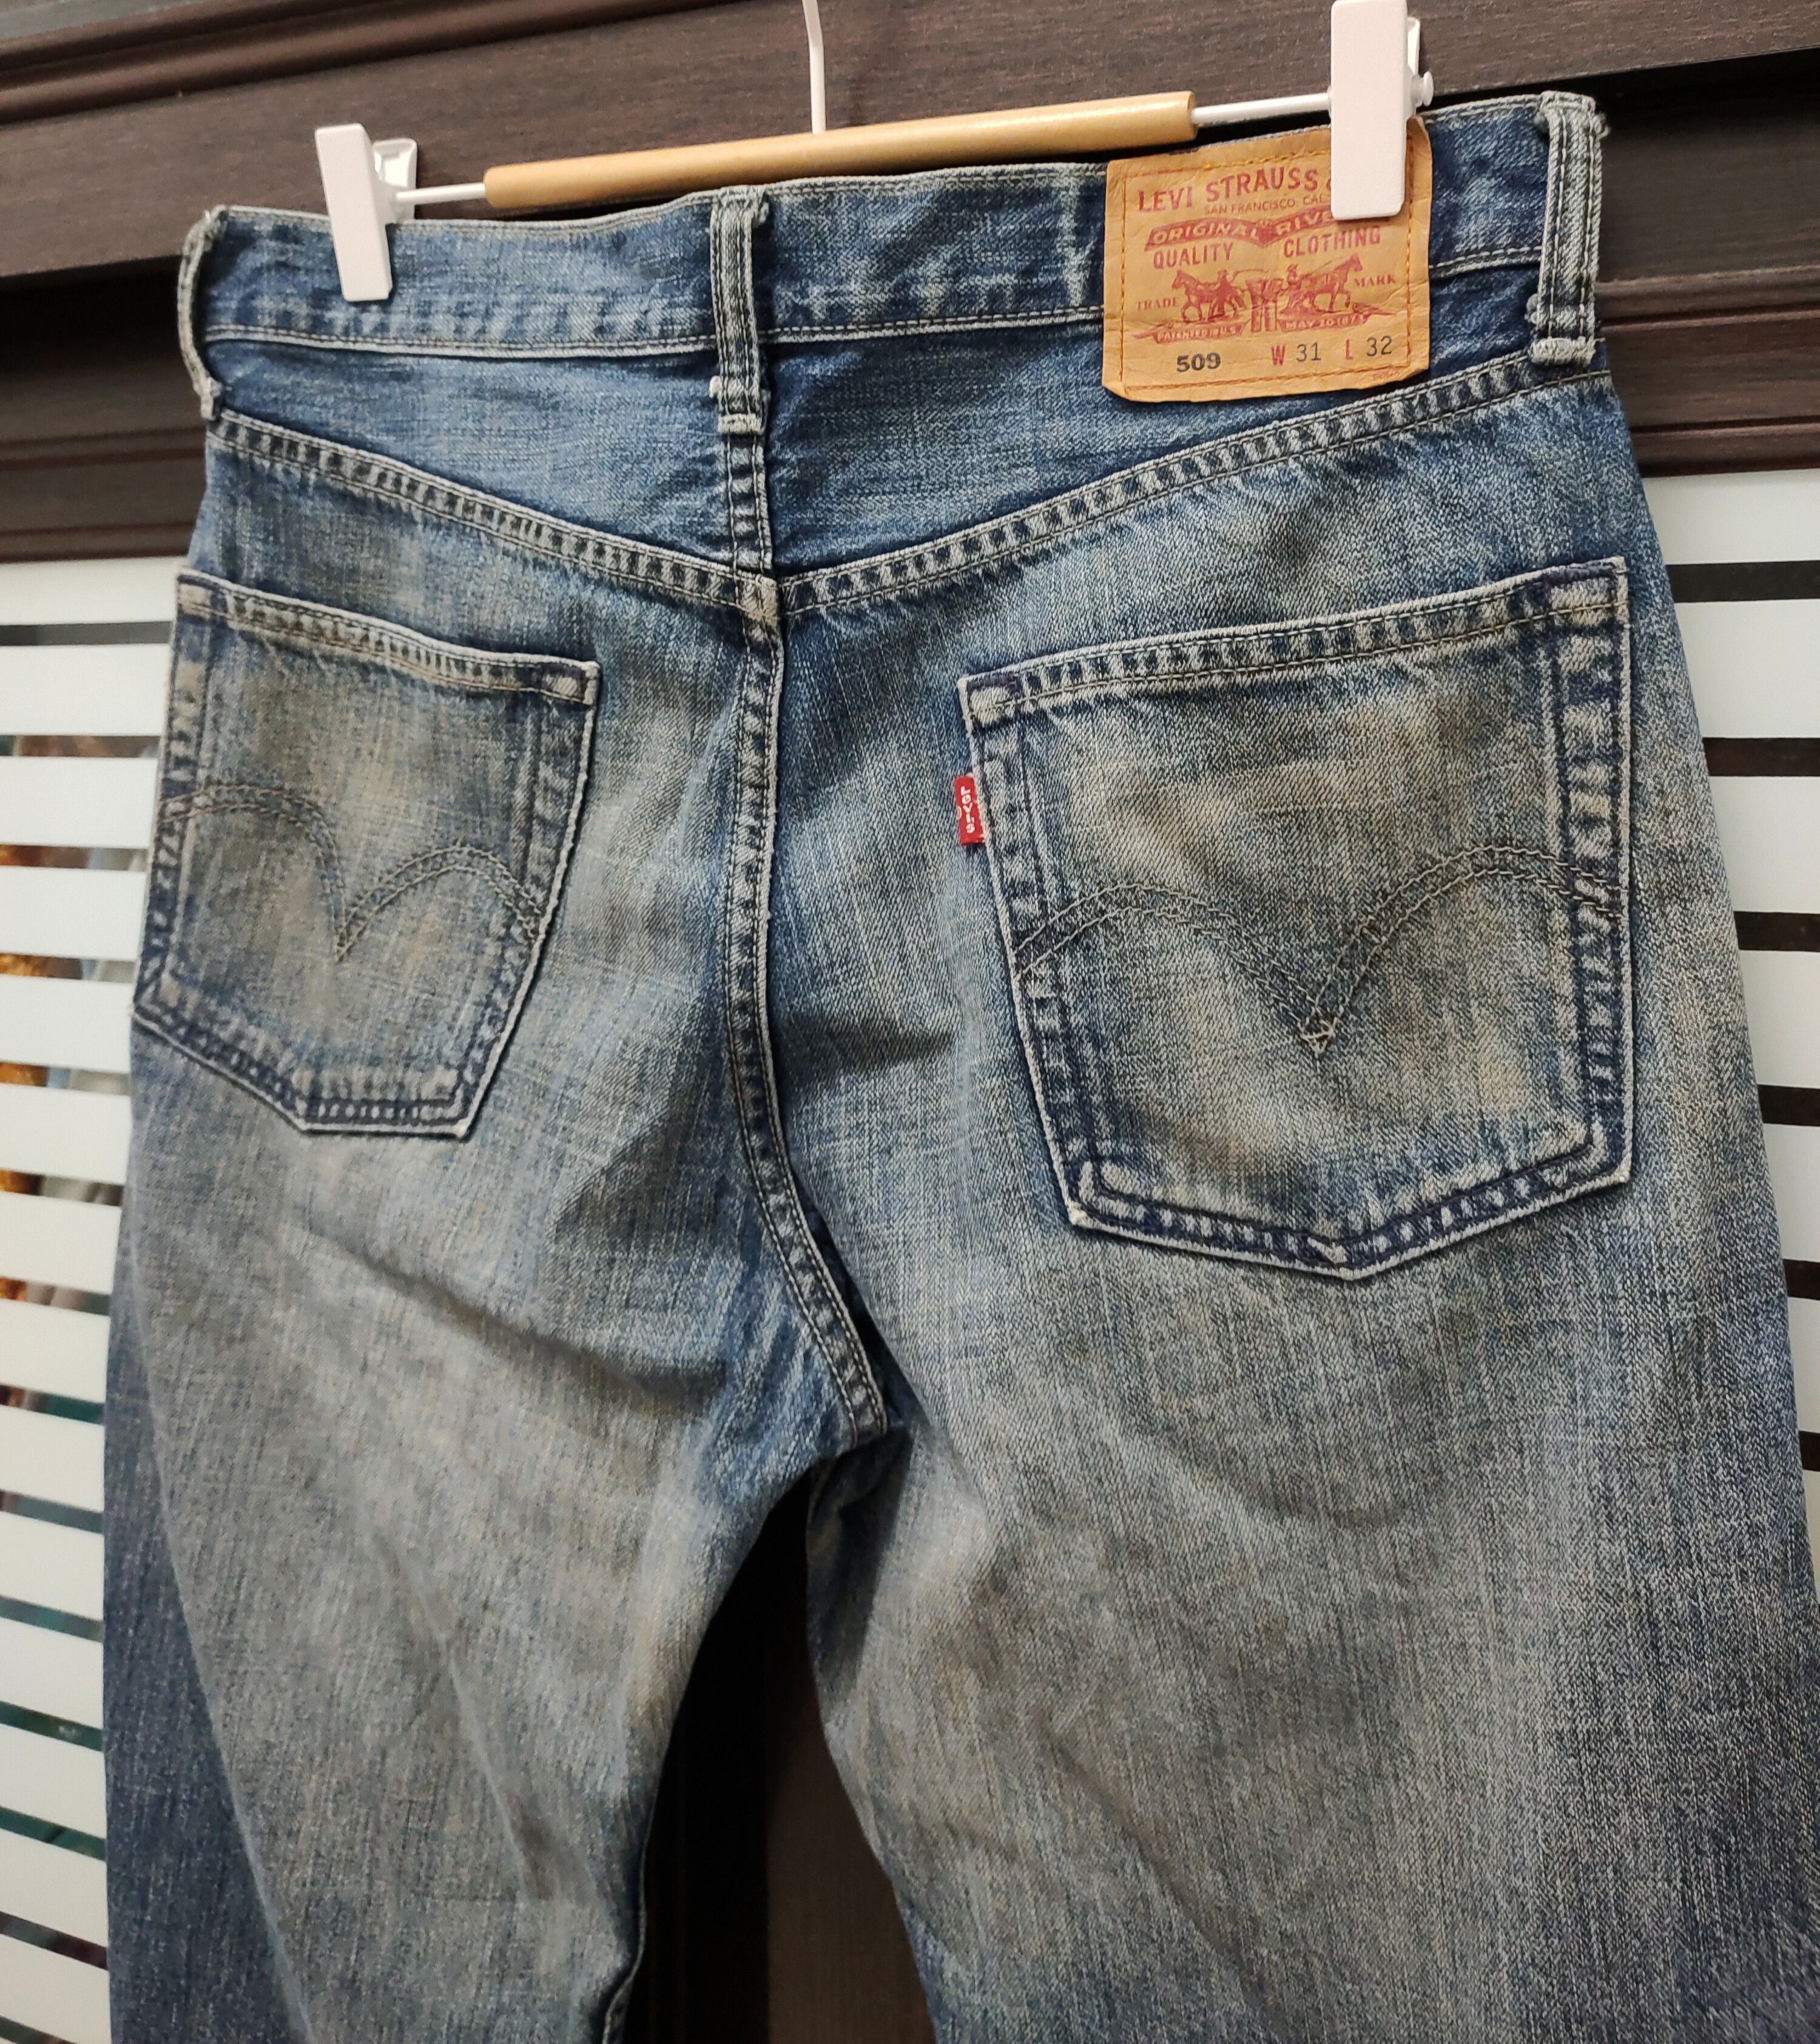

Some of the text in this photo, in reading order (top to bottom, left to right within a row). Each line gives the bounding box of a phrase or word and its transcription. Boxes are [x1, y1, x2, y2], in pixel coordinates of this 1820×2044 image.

[1138, 186, 1193, 212] LEVI
[1205, 166, 1318, 203] STRAUSS
[1204, 203, 1227, 214] SAN
[1153, 211, 1333, 244] ORIGINAL RIVE
[1153, 225, 1381, 269] QUALITY CLOTHING
[1138, 274, 1396, 311] TRADE MARK
[1271, 342, 1322, 366] W 31
[1345, 335, 1392, 360] L 32
[1176, 352, 1221, 373] 509
